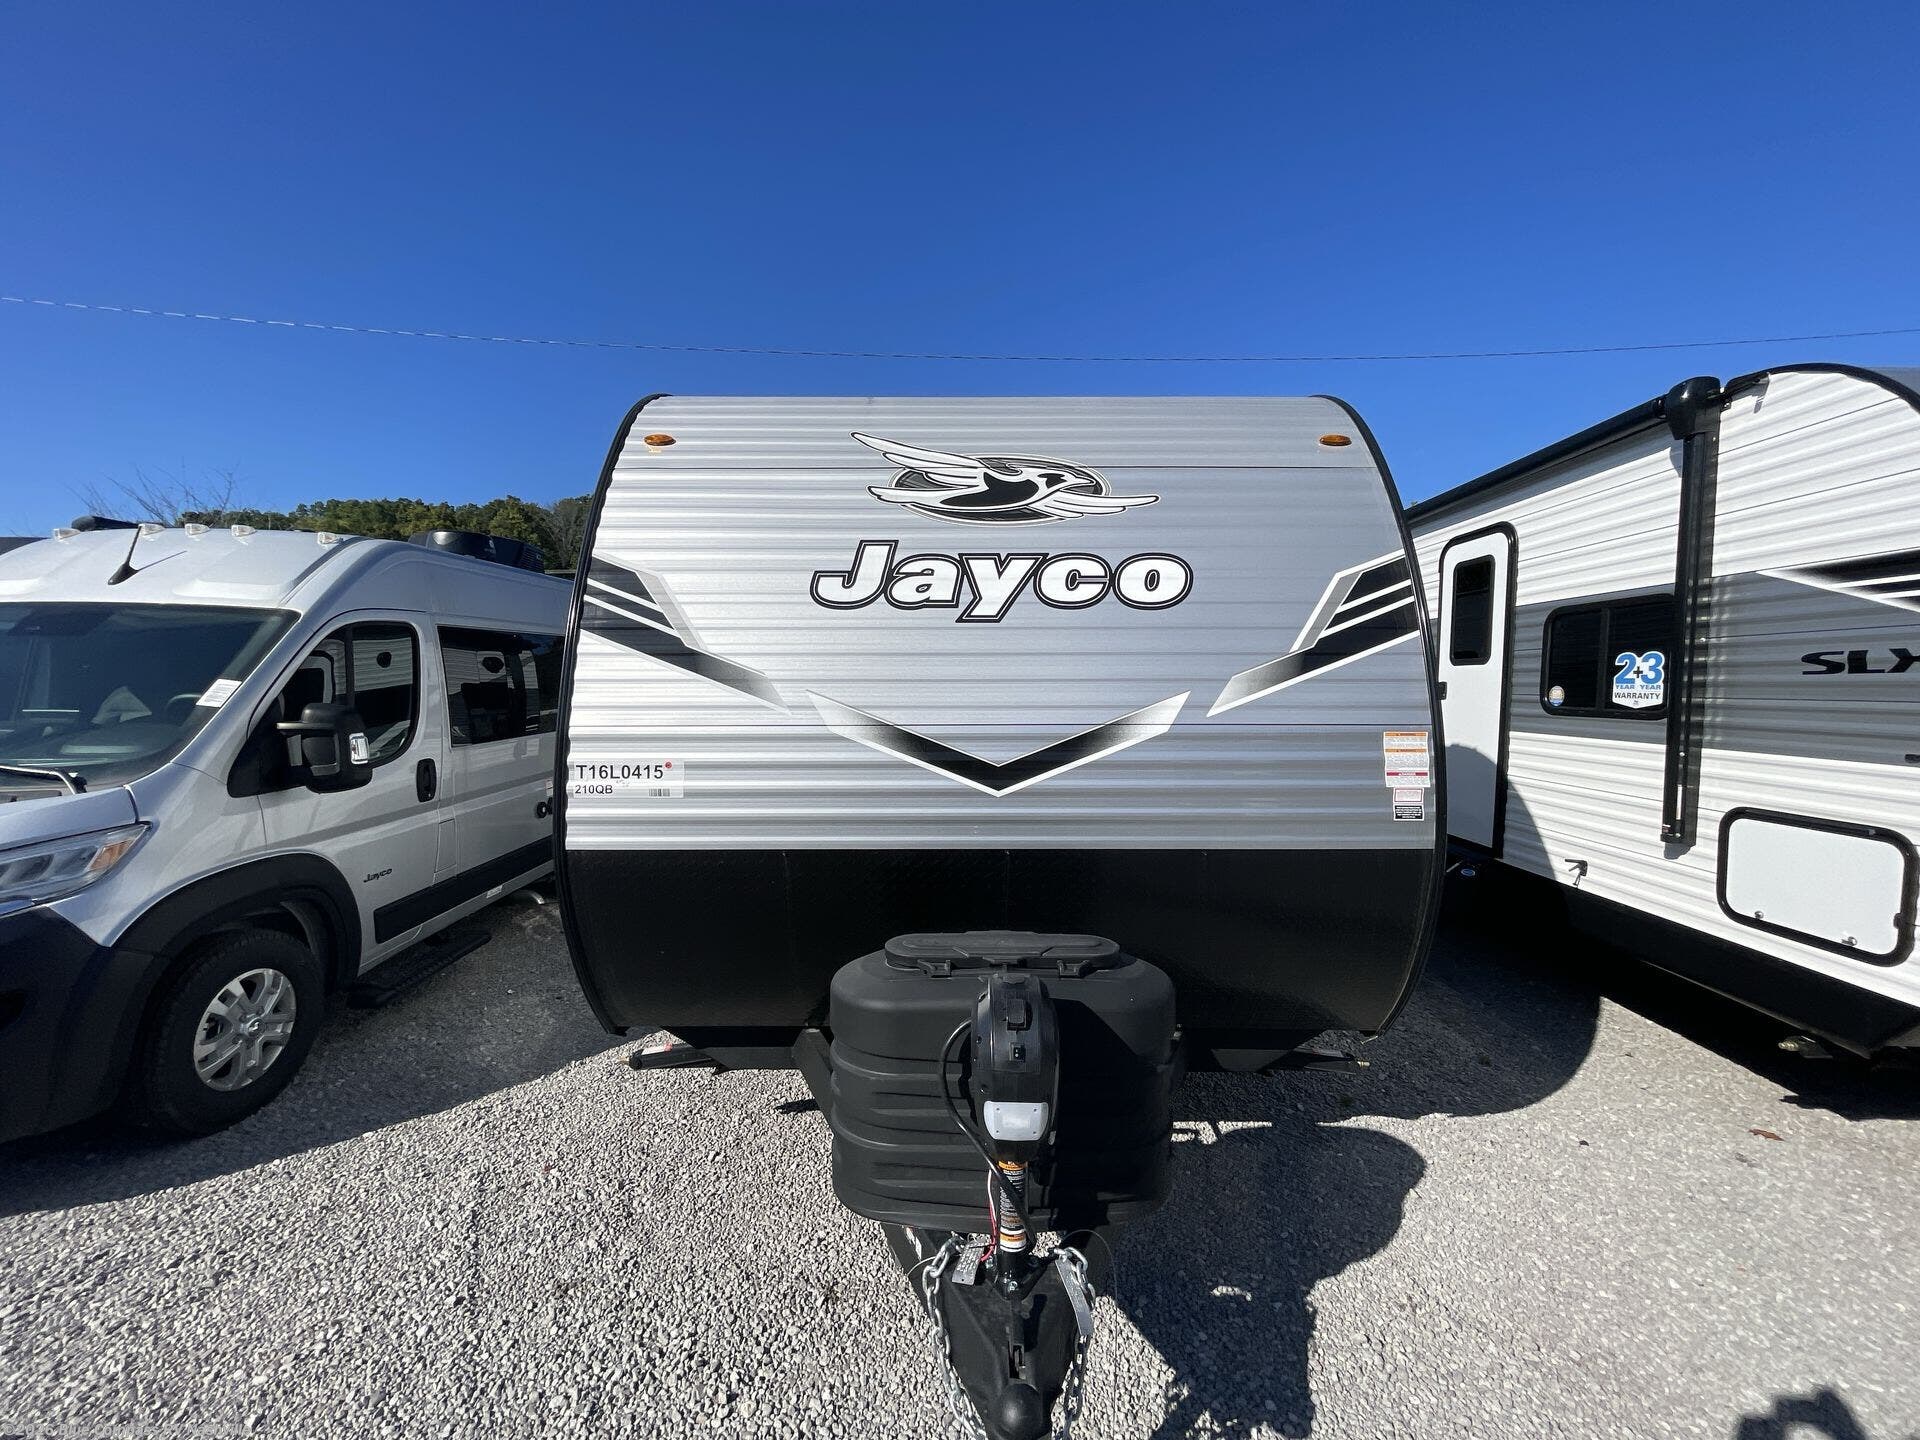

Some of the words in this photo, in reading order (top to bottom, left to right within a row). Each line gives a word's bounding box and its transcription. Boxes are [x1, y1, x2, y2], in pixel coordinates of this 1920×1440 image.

[809, 539, 1194, 623] Jayco
[1614, 692, 1661, 700] WARRANTY
[575, 764, 664, 779] T16L0415
[574, 785, 613, 794] 210QB
